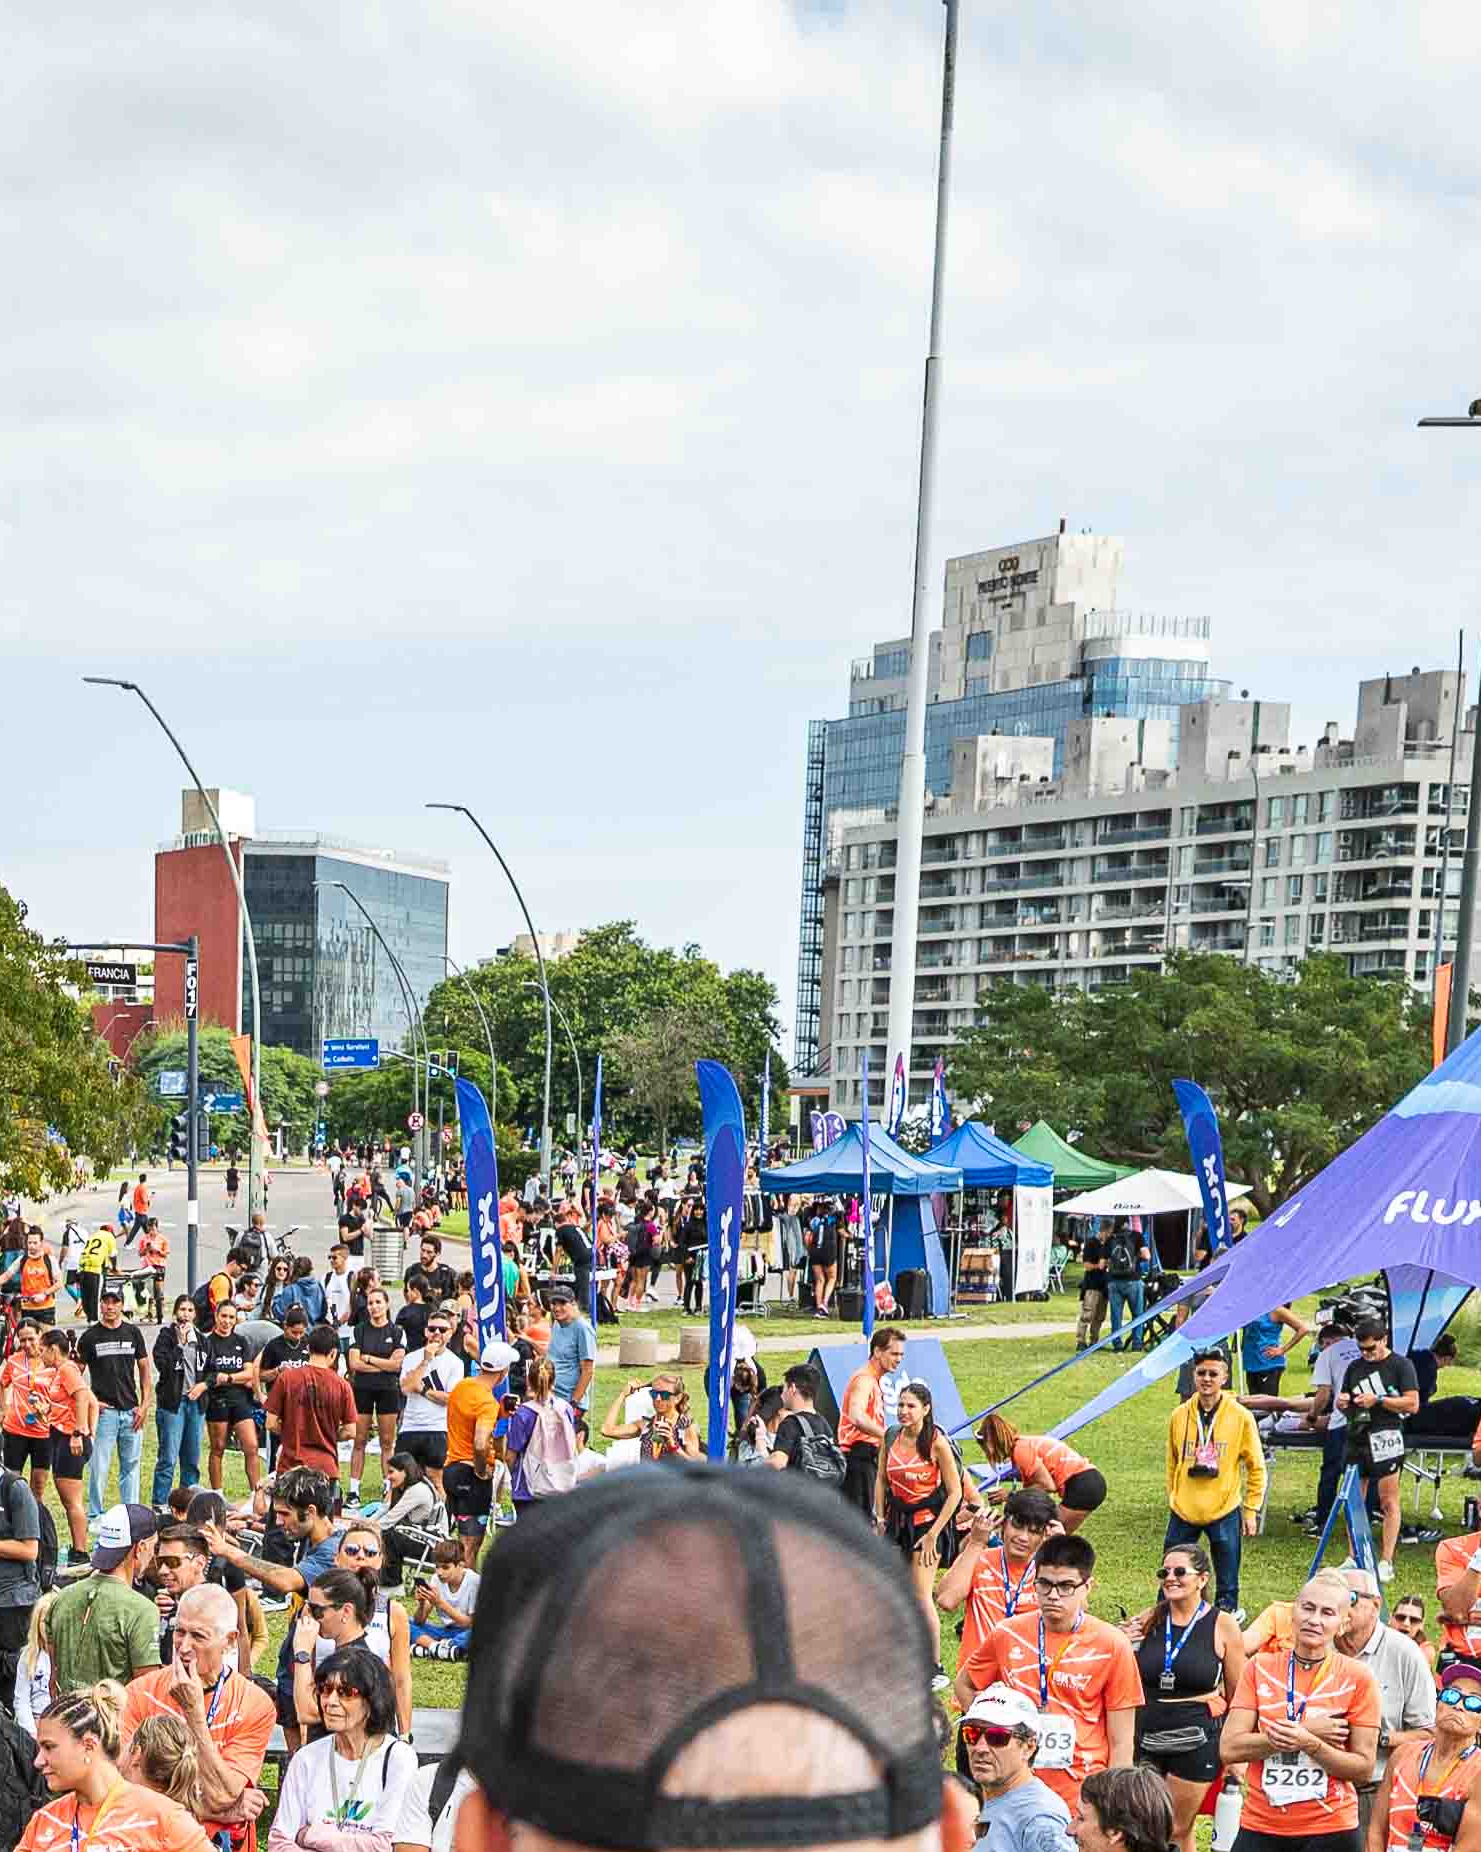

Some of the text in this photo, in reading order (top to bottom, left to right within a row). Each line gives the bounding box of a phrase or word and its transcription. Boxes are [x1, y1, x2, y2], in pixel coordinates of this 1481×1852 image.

[88, 966, 130, 981] FRANCIA
[186, 962, 197, 1017] F017
[1264, 1768, 1326, 1787] 5262
